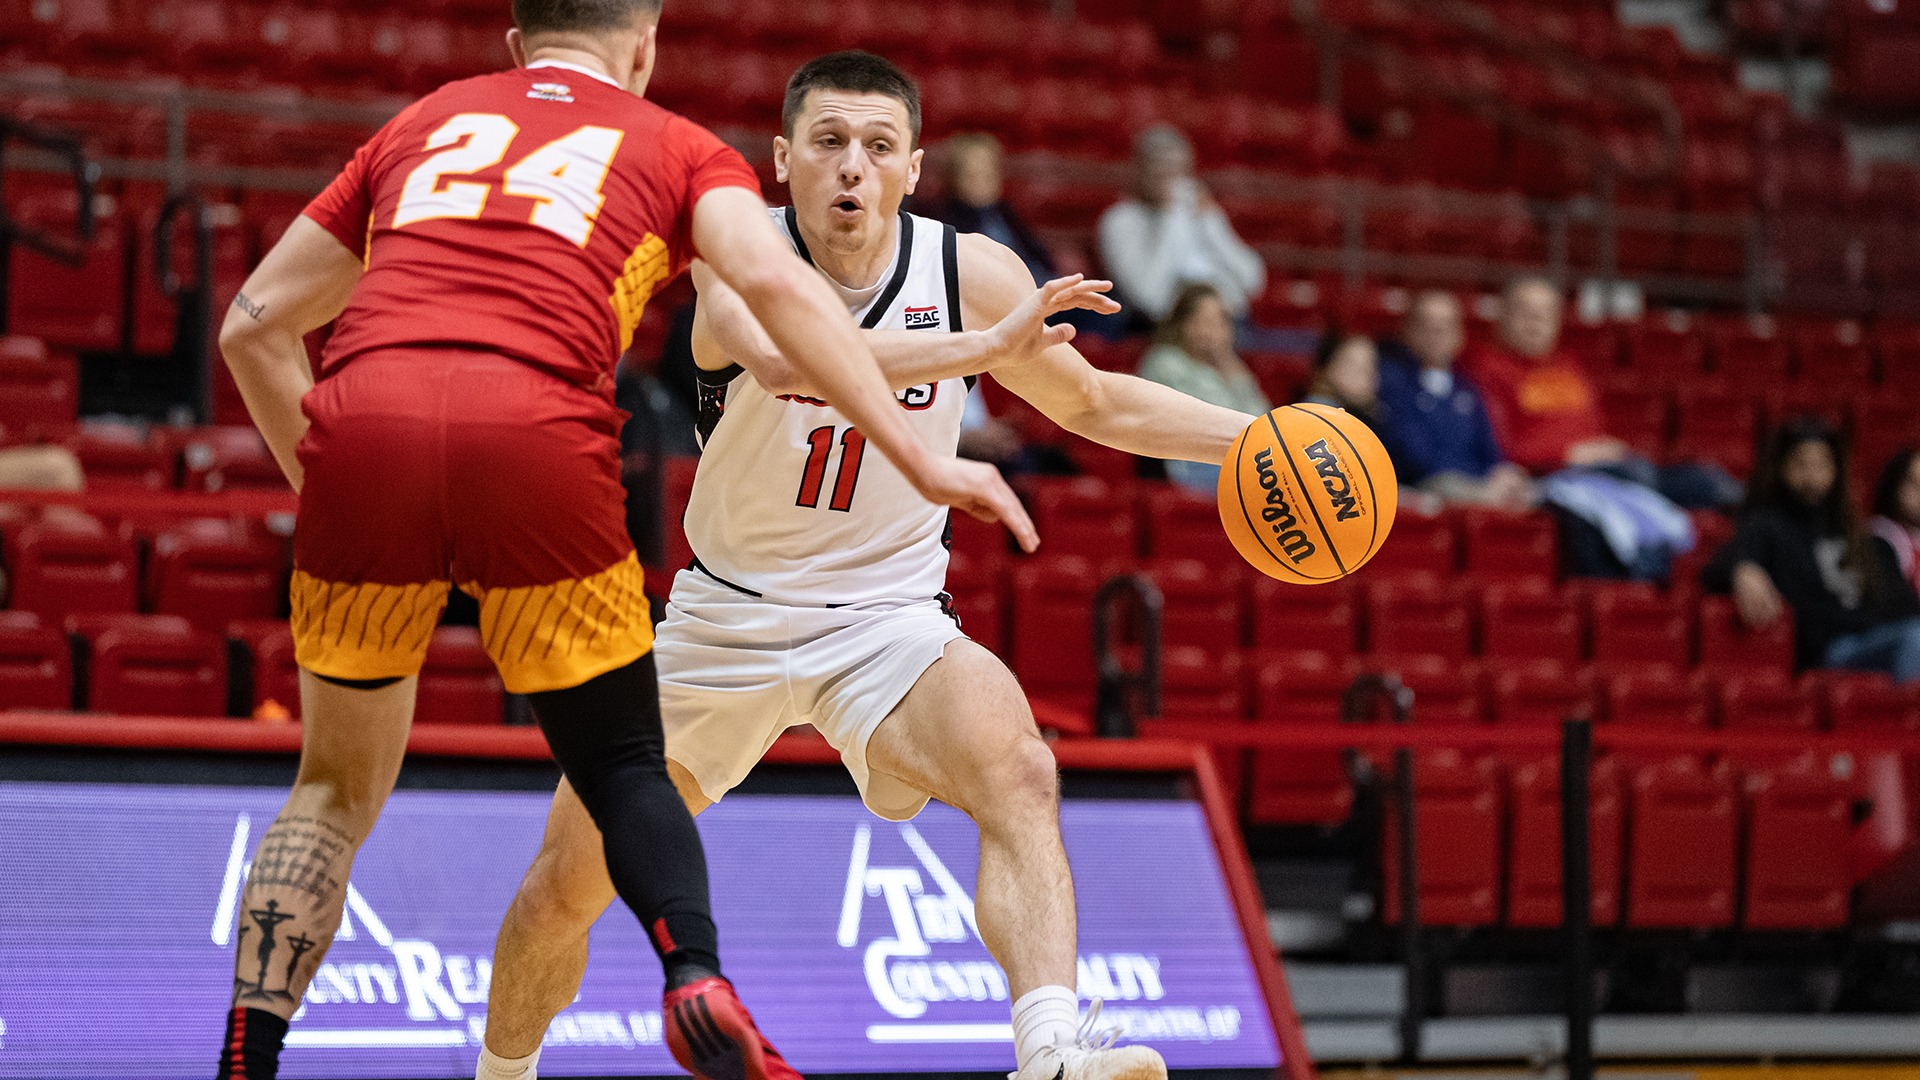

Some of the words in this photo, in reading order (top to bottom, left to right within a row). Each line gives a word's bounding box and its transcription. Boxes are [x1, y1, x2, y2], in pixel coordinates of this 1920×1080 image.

[392, 113, 625, 249] 24
[904, 311, 940, 324] PSAC
[795, 425, 866, 513] 11
[1253, 446, 1316, 565] Wilson
[1303, 438, 1361, 522] NCAA
